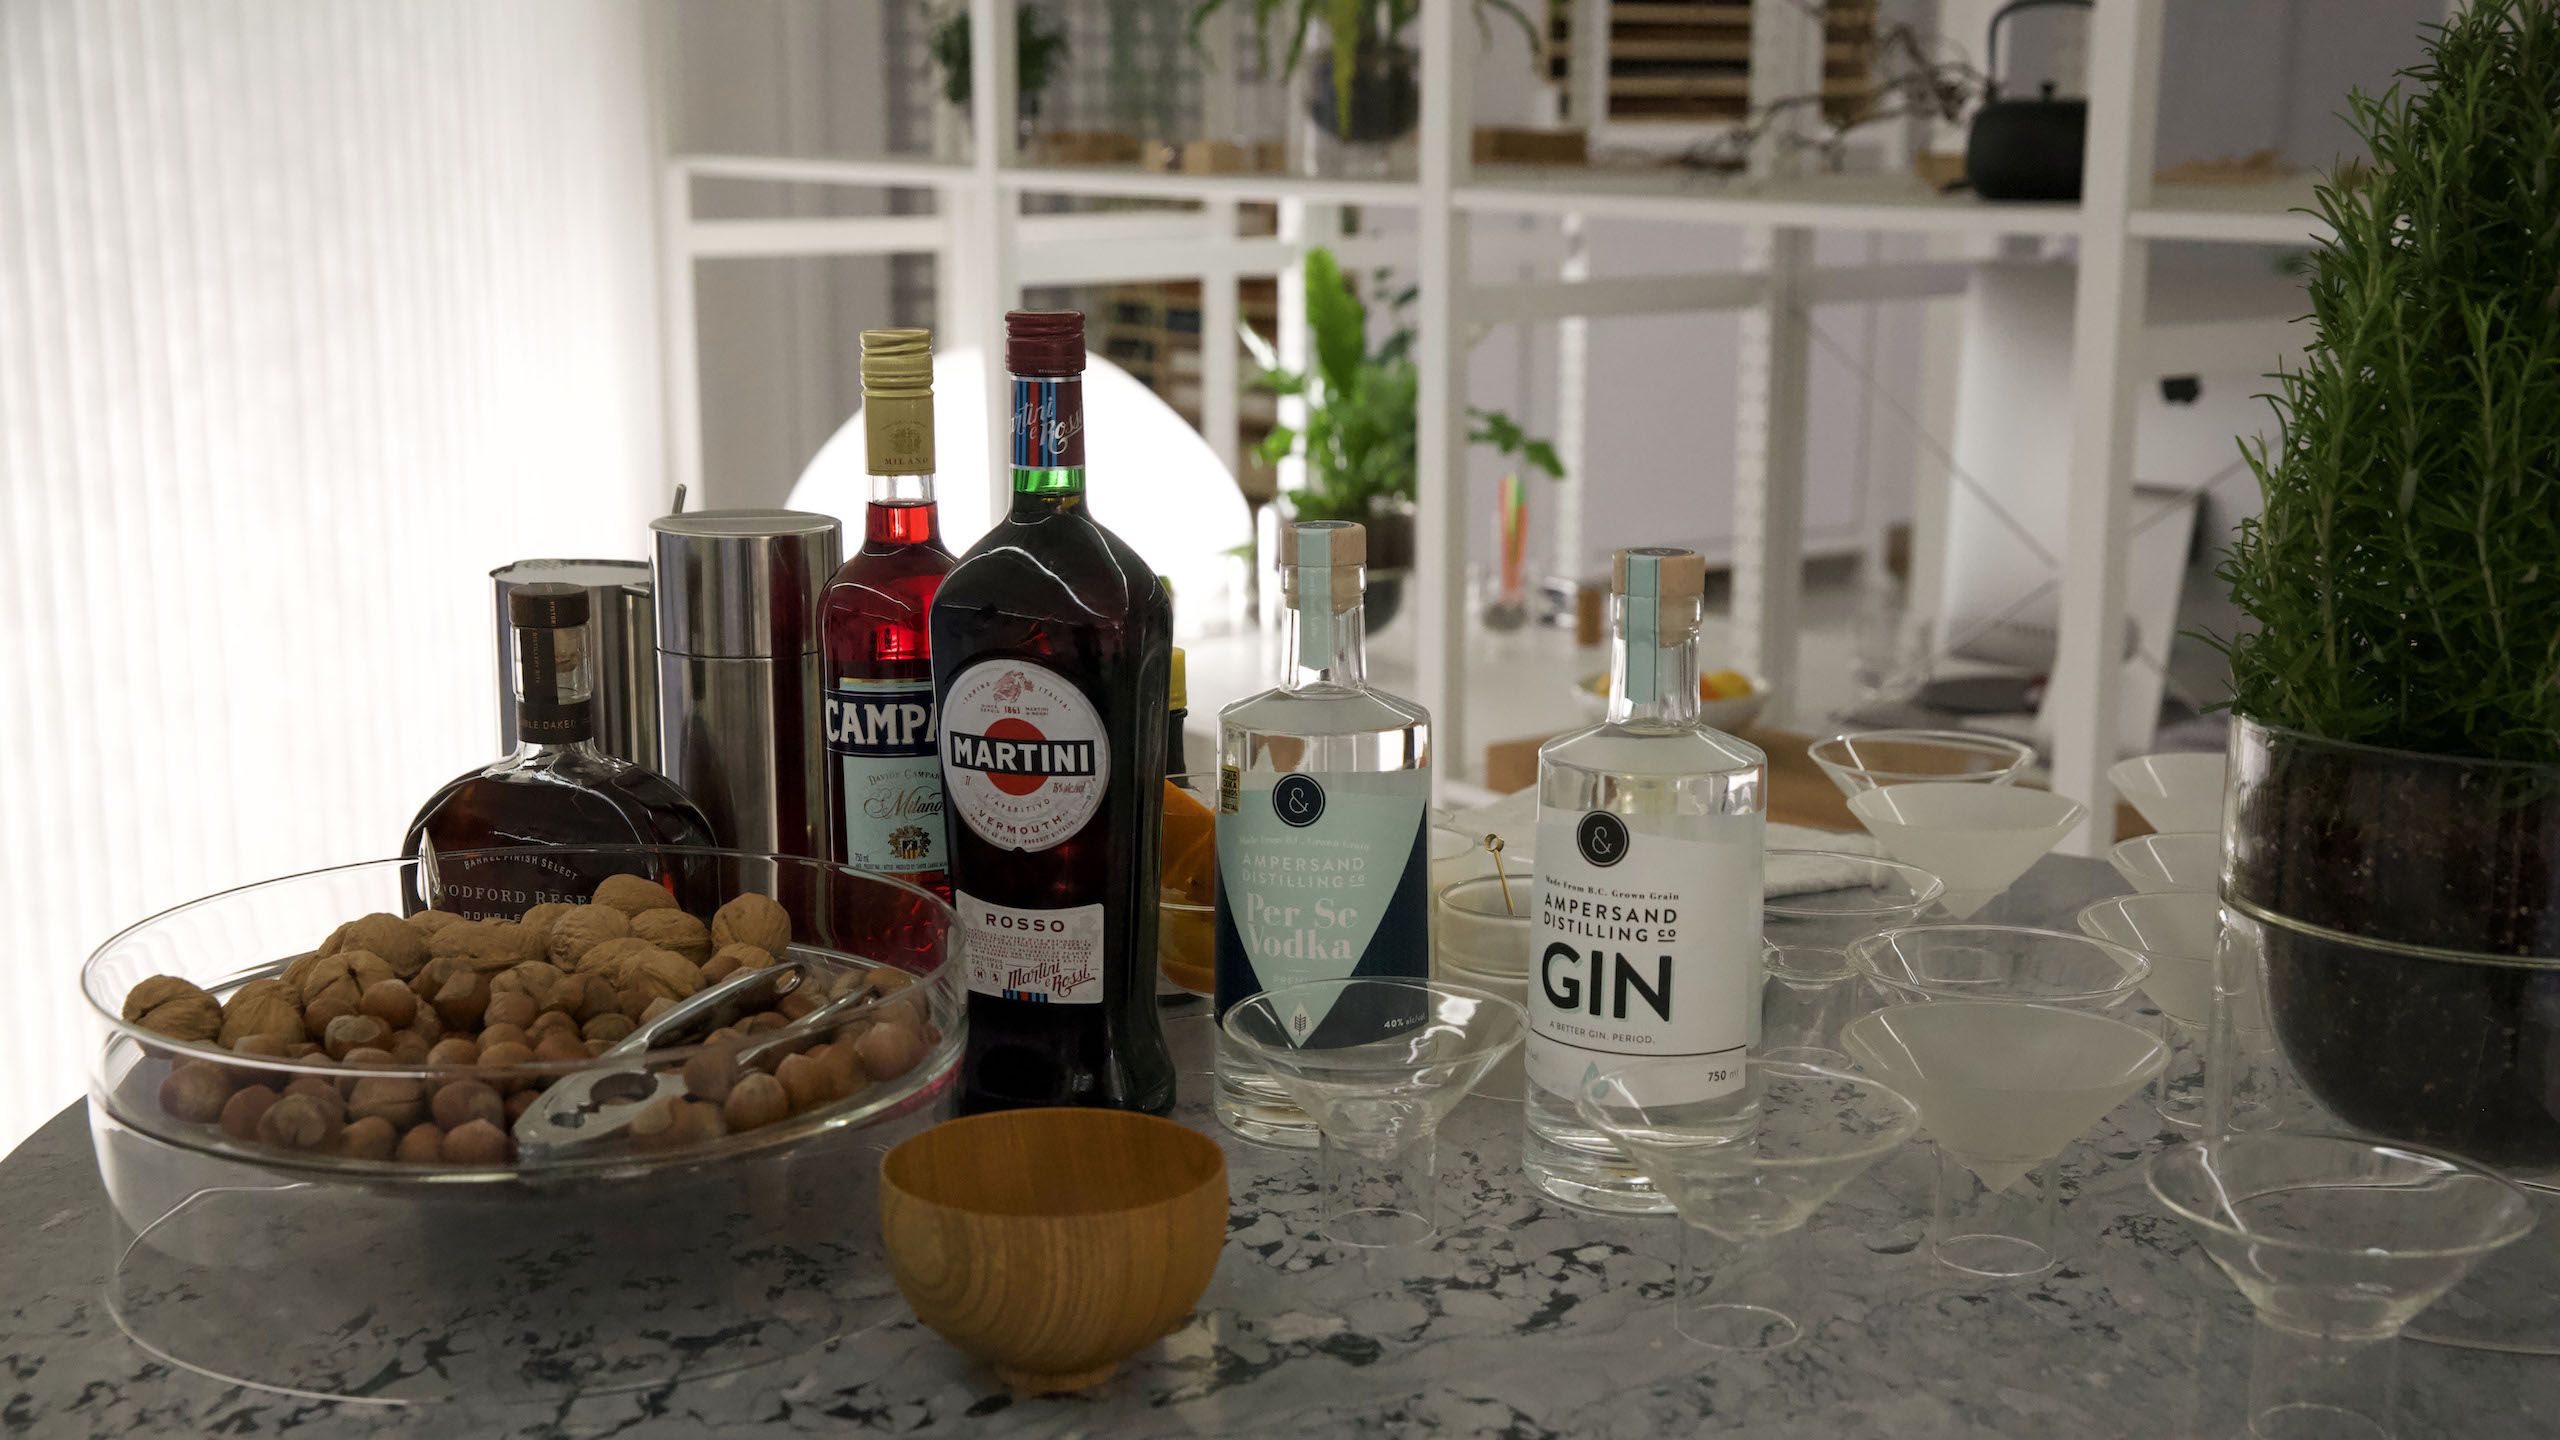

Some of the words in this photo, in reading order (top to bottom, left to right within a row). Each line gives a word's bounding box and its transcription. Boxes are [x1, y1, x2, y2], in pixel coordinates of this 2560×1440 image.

[884, 456, 929, 465] MILANO
[543, 719, 577, 731] OAKED
[952, 735, 1090, 773] MARTINI
[864, 785, 944, 821] Milano
[1288, 787, 1310, 815] &
[978, 809, 1062, 835] VERMOUTH
[1591, 826, 1613, 855] &
[541, 858, 578, 881] SELECT
[1242, 852, 1366, 873] AMPERSAND
[1241, 869, 1346, 889] DISTILLING
[1348, 874, 1368, 885] CO
[1545, 874, 1561, 887] Made
[1563, 881, 1585, 893] From
[1588, 886, 1608, 896] B.C.
[1611, 890, 1646, 900] Grown
[1649, 892, 1680, 901] Grain
[443, 883, 527, 904] ODFORD
[535, 890, 593, 907] RESE
[1544, 892, 1678, 924] AMPERSAND
[985, 913, 1065, 933] ROSSO
[1246, 892, 1304, 928] Per
[1314, 898, 1359, 930] Se
[1543, 911, 1649, 943] DISTILLING
[1657, 929, 1677, 939] CO
[1247, 922, 1354, 961] Vodka
[1008, 959, 1061, 992] Martini
[1541, 941, 1674, 1022] GIN
[1383, 1018, 1405, 1029] 40%
[1549, 1020, 1556, 1029] A
[1556, 1022, 1587, 1036] BETTER
[1588, 1029, 1610, 1041] GIN.
[1612, 1033, 1656, 1044] PERIOD.
[1707, 1070, 1727, 1082] 750
